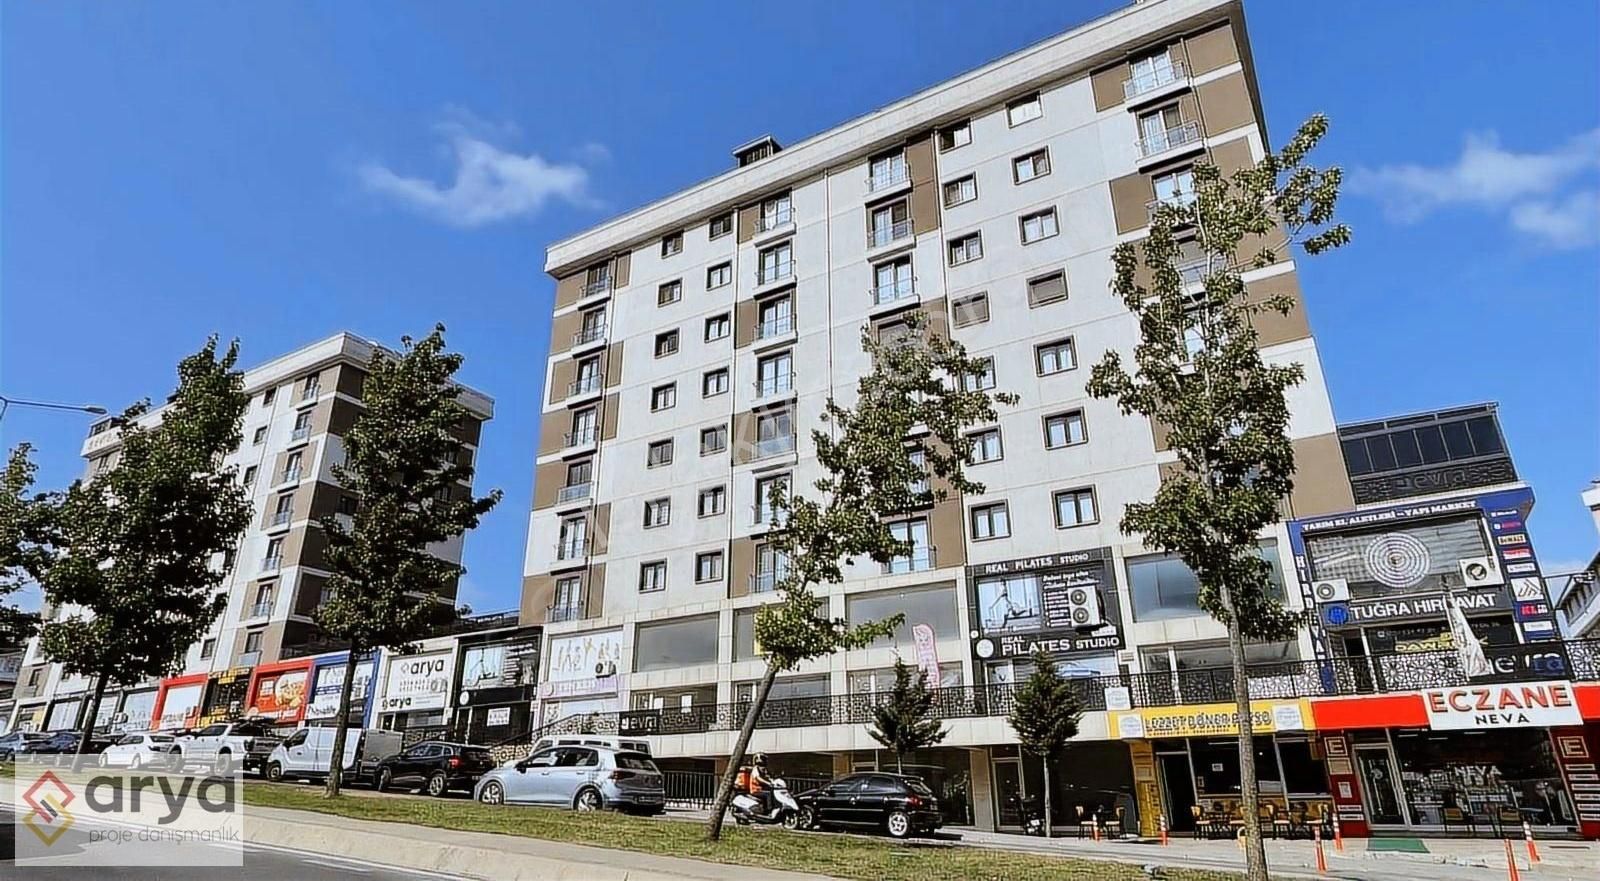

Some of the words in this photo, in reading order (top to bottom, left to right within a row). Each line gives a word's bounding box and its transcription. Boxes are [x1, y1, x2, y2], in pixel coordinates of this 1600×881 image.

[1430, 500, 1477, 513] MARKET
[985, 562, 1009, 574] REAL
[1059, 553, 1089, 565] STUDIO
[1351, 601, 1412, 620] TUĞRA
[1415, 593, 1497, 614] HIRAVAT
[1001, 635, 1025, 644] REAL
[410, 658, 445, 677] arya
[1428, 684, 1573, 713] ECZANE
[1475, 712, 1531, 725] NEVA
